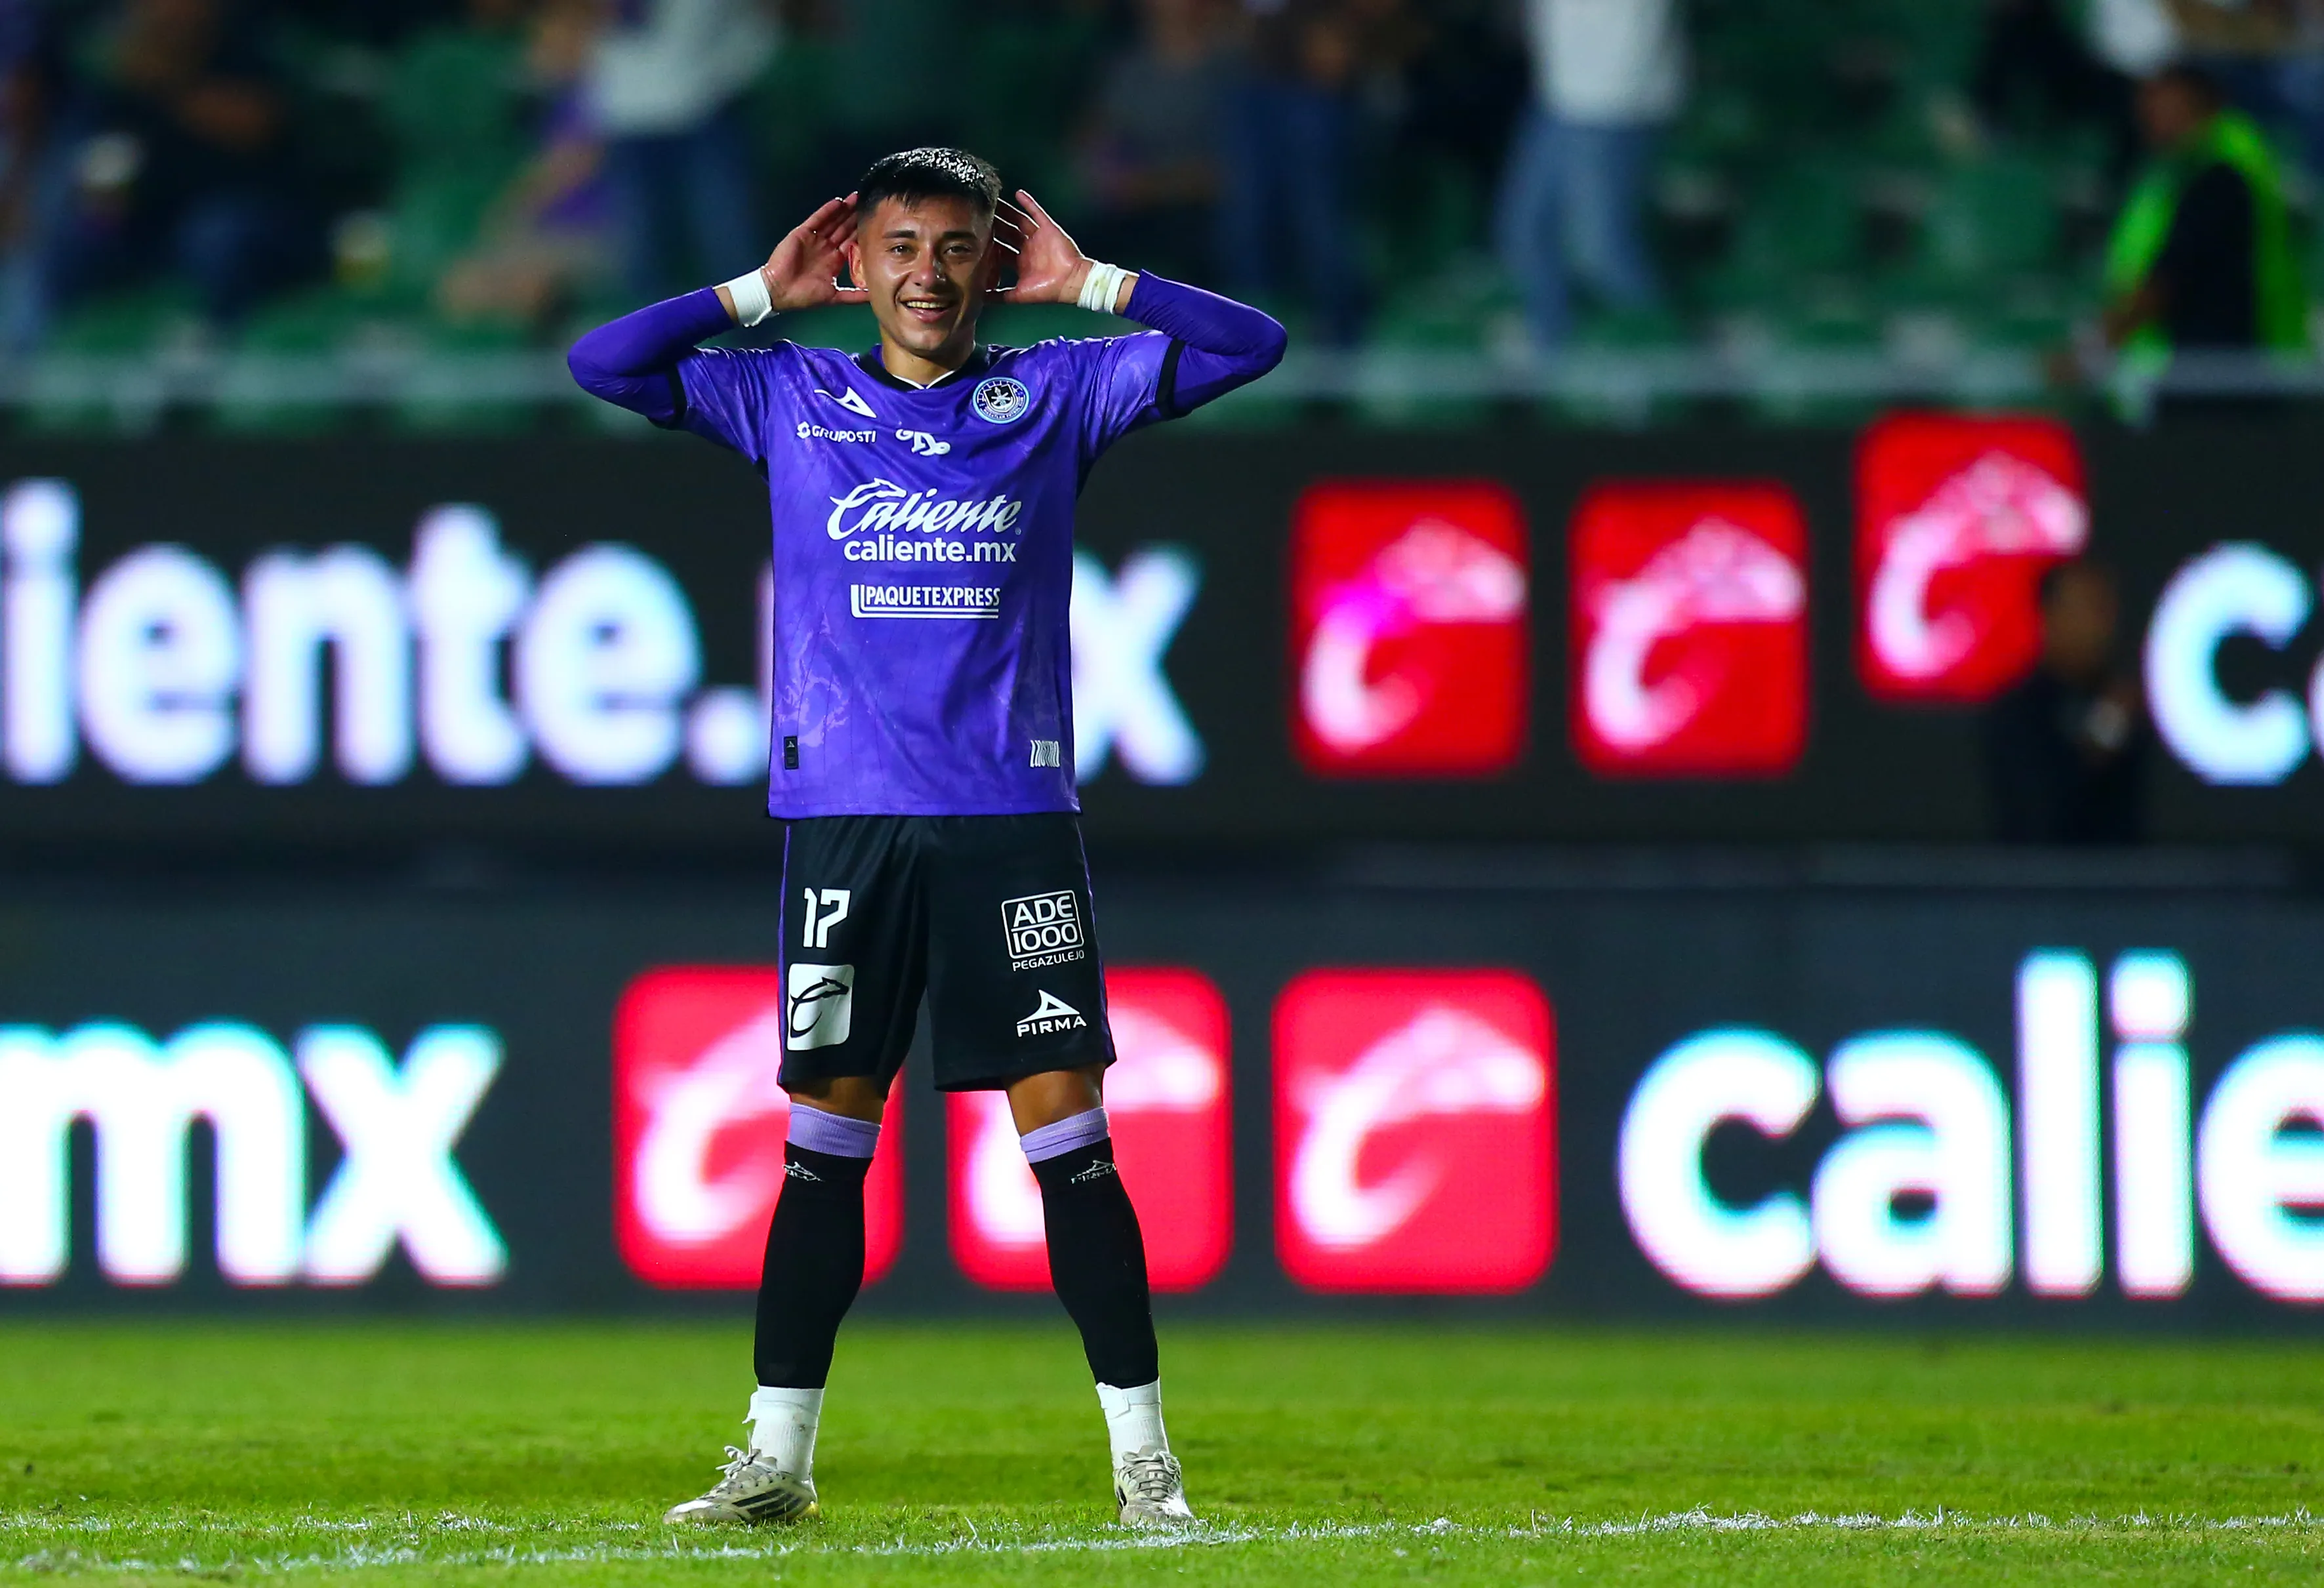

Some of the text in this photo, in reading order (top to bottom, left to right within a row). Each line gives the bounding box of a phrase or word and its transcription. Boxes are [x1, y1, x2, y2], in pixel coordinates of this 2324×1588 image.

[826, 478, 1022, 540] Caliente
[844, 534, 1017, 562] caliente.mx
[866, 586, 1001, 606] PAQUETEXPRESS
[2141, 542, 2324, 787] c
[803, 887, 851, 948] 17
[1013, 895, 1074, 927] ADE
[1012, 923, 1078, 953] 1000
[1012, 949, 1085, 972] PEGAZULEJO
[1017, 1015, 1087, 1038] PIRMA
[1616, 947, 2324, 1303] calie
[0, 1017, 509, 1288] mx
